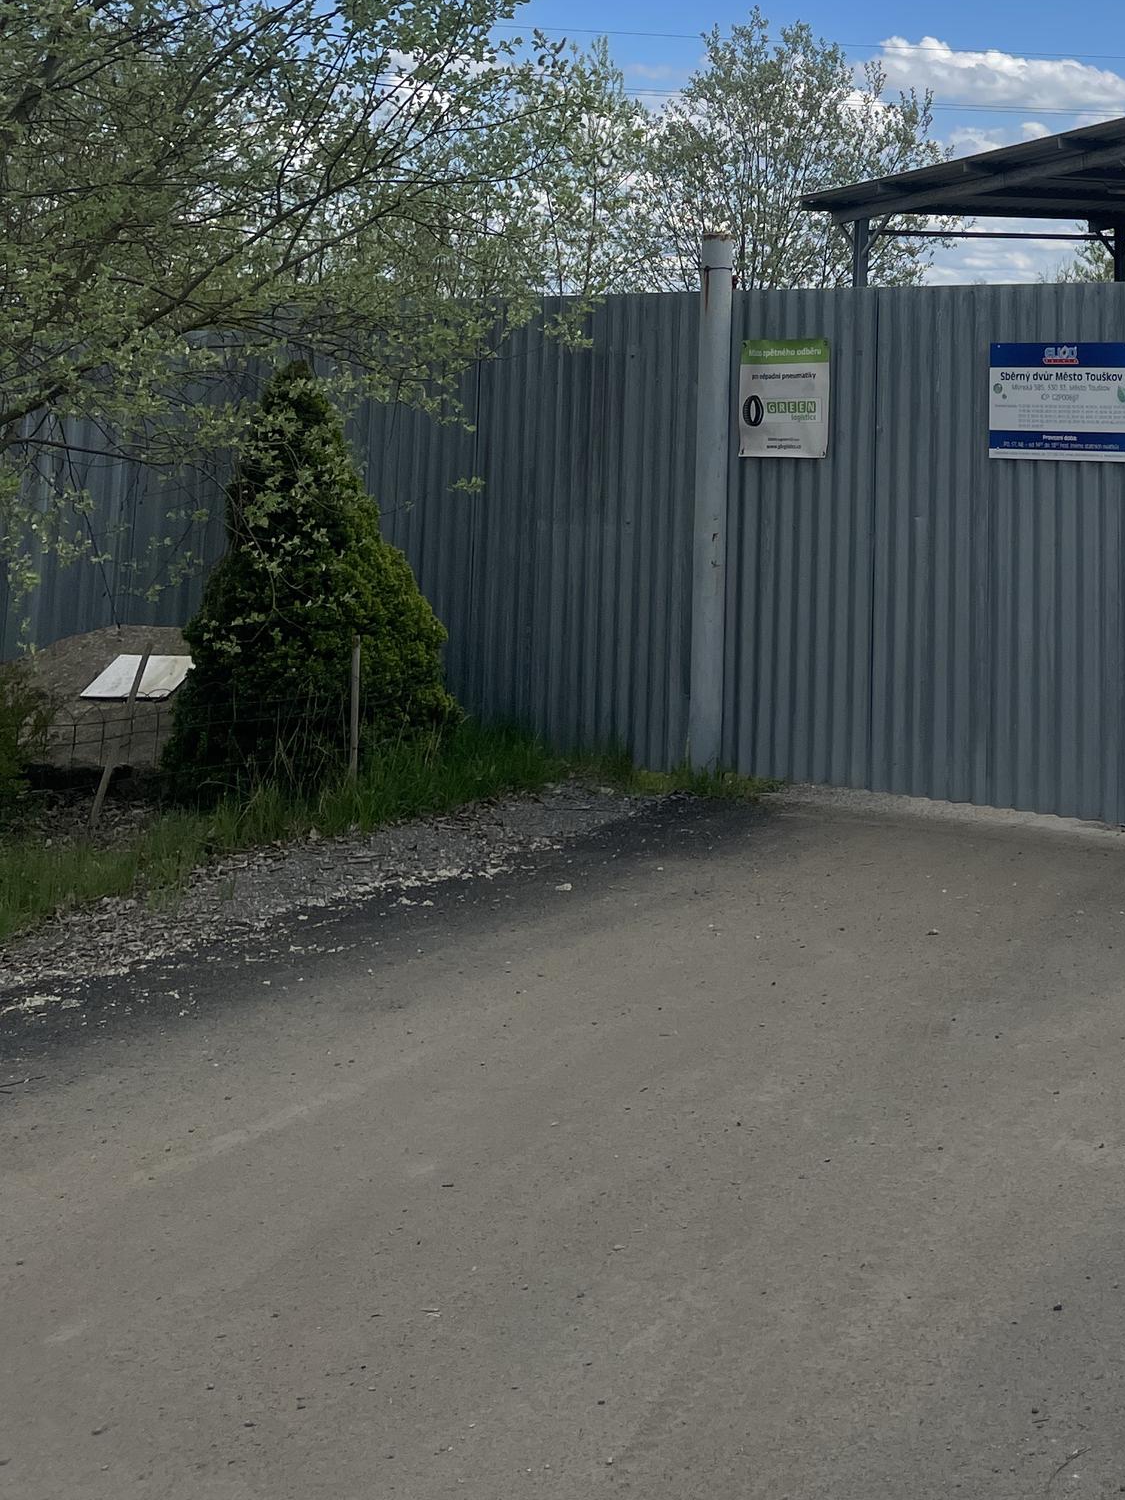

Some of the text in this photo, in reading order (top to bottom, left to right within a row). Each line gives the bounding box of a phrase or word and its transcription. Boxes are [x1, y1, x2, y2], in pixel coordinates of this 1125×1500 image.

[796, 347, 822, 356] odběru
[1000, 371, 1123, 382] Sběrný dvůr Město Touškov
[767, 401, 816, 413] GREEN
